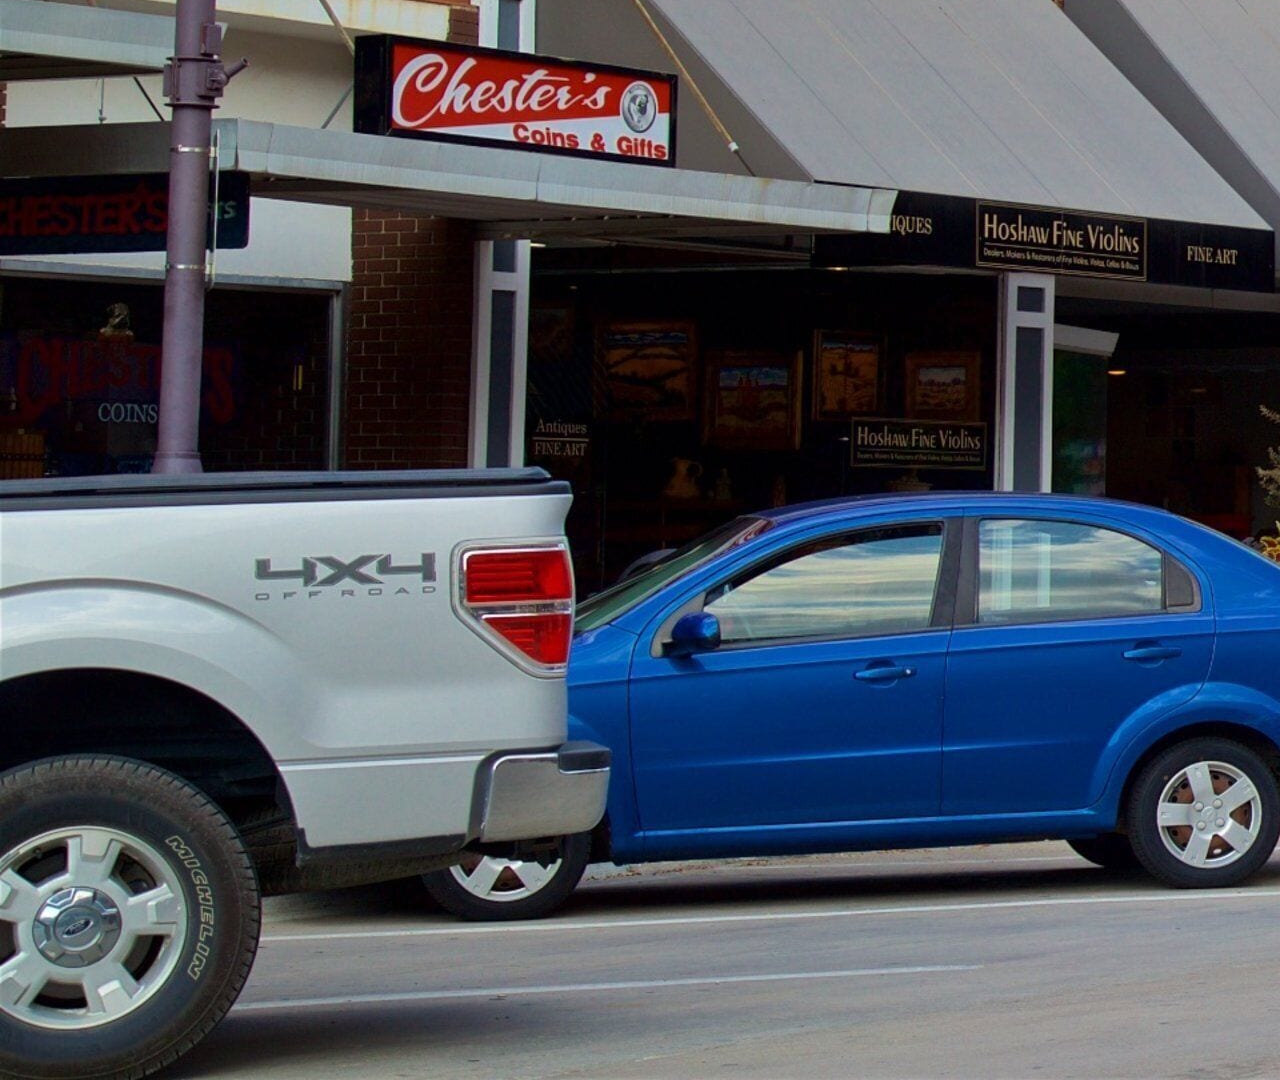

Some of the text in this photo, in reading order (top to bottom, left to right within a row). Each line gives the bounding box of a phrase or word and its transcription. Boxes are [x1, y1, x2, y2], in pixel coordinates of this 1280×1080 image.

[392, 52, 613, 128] Chester's
[512, 123, 667, 160] Coins & Gifts
[1187, 245, 1238, 265] FINE ART
[98, 403, 159, 424] COINS
[536, 418, 588, 437] Antiques
[535, 441, 588, 457] FINE ART
[255, 552, 437, 588] 4X4
[255, 585, 437, 601] OFF ROAD
[165, 835, 215, 981] MICHELIN
